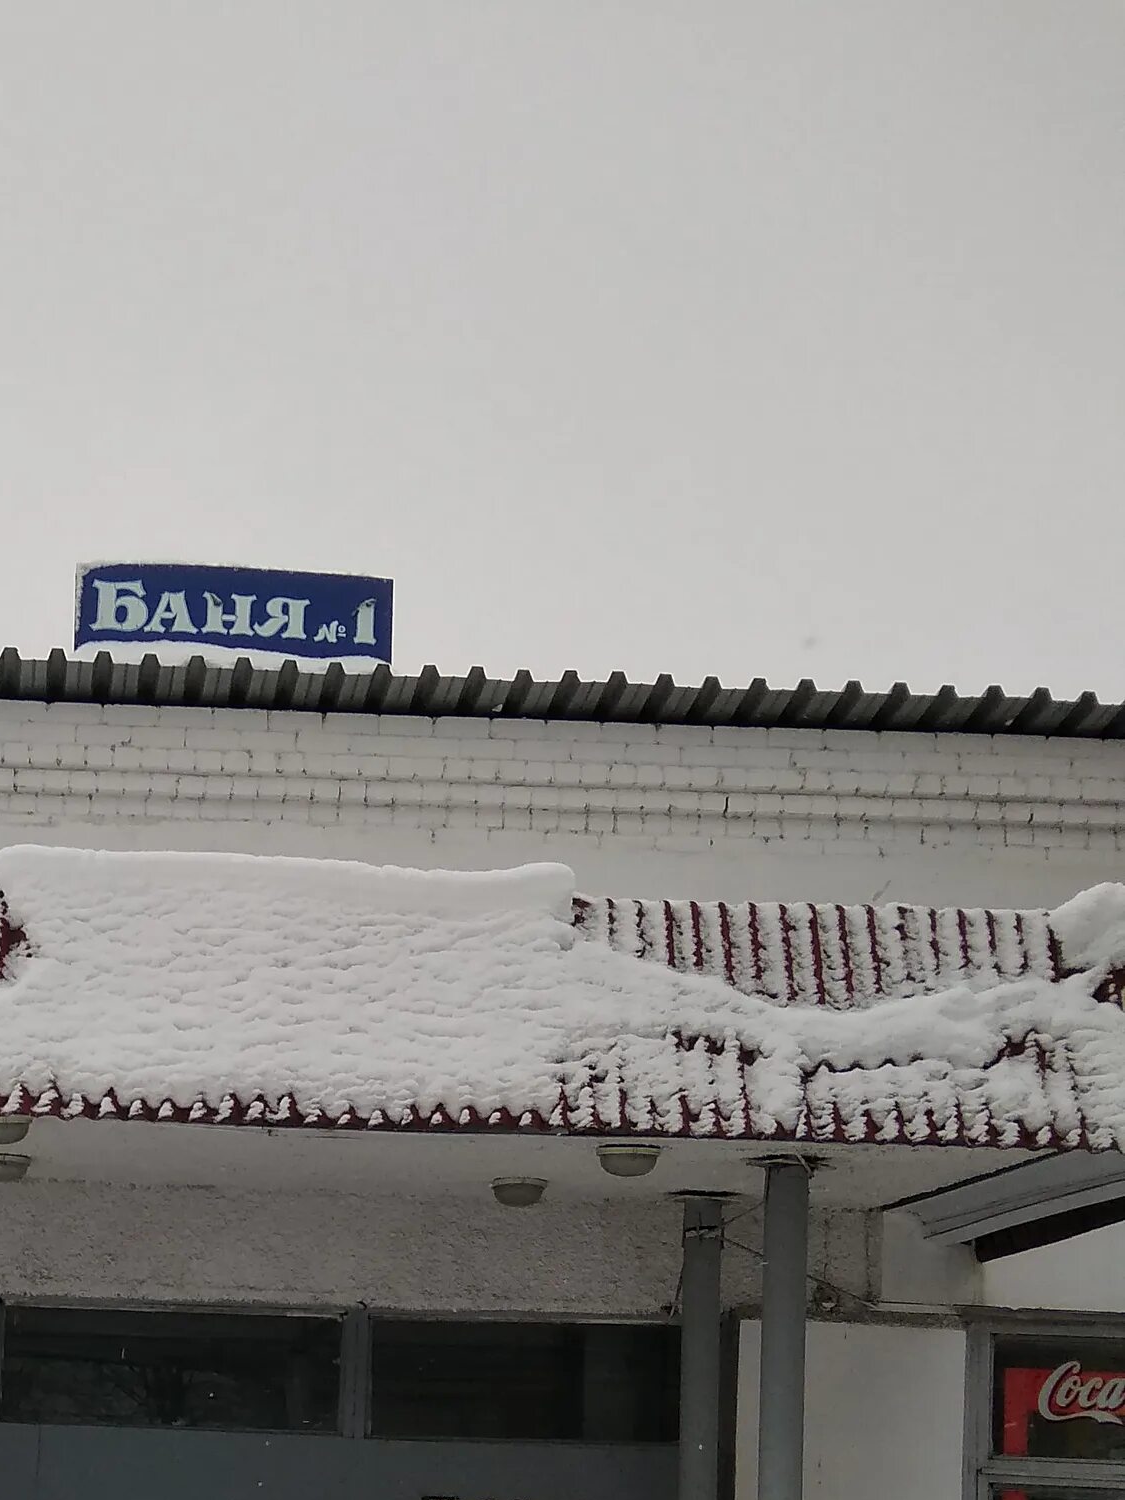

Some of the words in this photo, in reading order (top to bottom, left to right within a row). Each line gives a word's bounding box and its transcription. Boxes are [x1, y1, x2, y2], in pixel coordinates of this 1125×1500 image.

[89, 579, 310, 640] БАНЯ
[353, 598, 377, 645] 1
[1038, 1361, 1125, 1424] Coca
